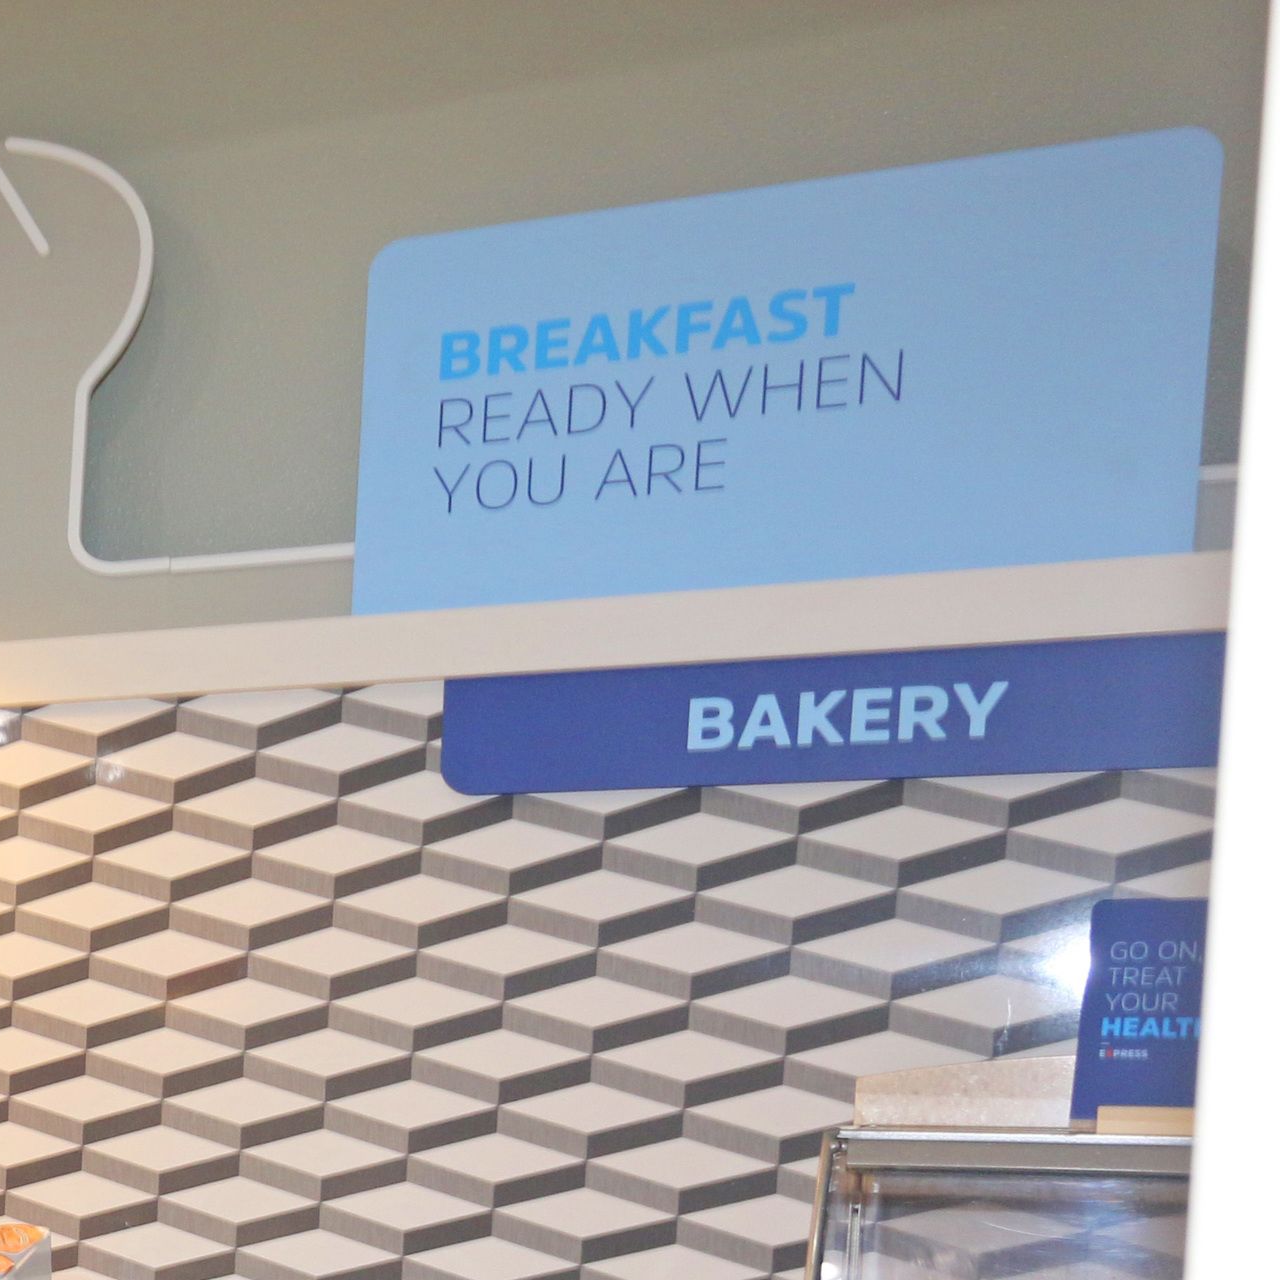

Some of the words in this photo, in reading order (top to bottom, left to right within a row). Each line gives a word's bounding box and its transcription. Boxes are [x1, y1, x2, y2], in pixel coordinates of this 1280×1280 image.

[440, 283, 856, 382] BREAKFAST
[437, 376, 655, 449] READY
[684, 349, 905, 421] WHEN
[432, 454, 567, 514] YOU
[594, 438, 728, 500] ARE
[687, 681, 1009, 753] BAKERY
[1109, 966, 1186, 986] TREAT
[1110, 941, 1148, 961] GO
[1106, 993, 1179, 1012] YOUR
